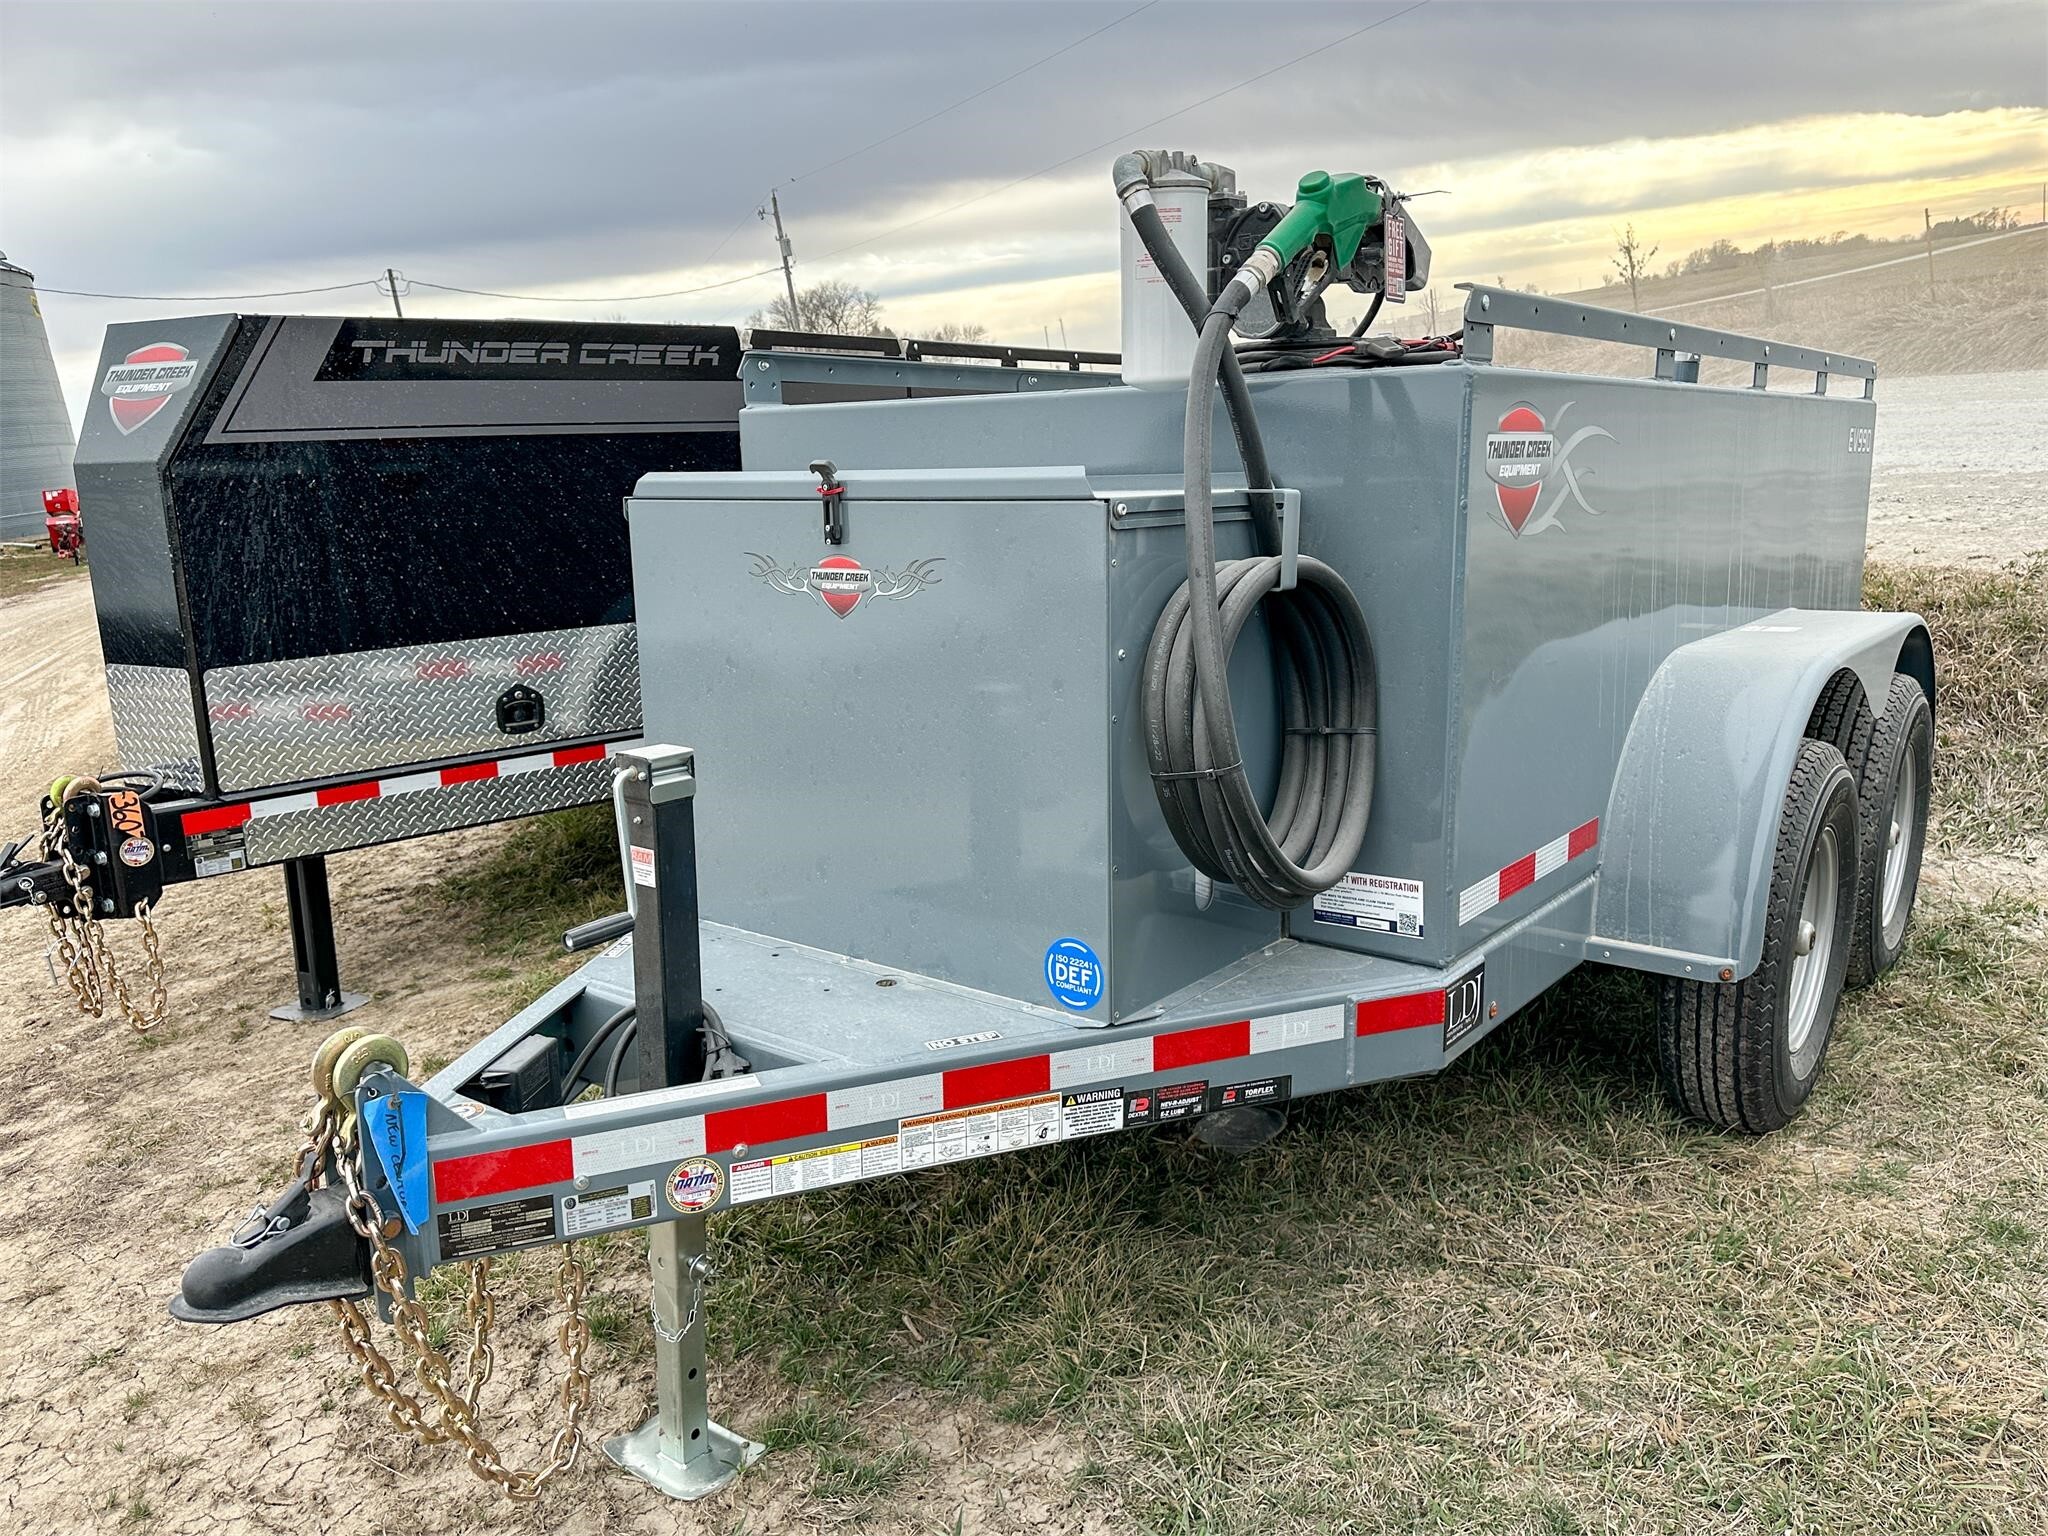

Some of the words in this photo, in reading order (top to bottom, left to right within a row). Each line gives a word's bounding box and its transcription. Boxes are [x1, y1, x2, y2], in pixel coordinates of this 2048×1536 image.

[1388, 219, 1403, 240] FREE
[1388, 238, 1403, 258] GIFT
[352, 339, 571, 365] THUNDER
[580, 343, 722, 367] CREEK
[106, 367, 157, 383] THUNDER
[157, 364, 192, 380] CREEK
[114, 381, 174, 394] EQUIPMENT
[1488, 441, 1525, 459] THUNDER
[1526, 440, 1552, 458] CREEK
[1499, 463, 1541, 478] EQUIPMENT
[811, 570, 844, 583] THUNDER
[845, 572, 869, 583] CREEK
[821, 582, 860, 591] EQUIPMENT
[1350, 876, 1369, 887] WITH
[1369, 878, 1419, 894] REGISTRATION
[1055, 953, 1069, 964] ISO
[1070, 957, 1093, 970] 22241
[1055, 962, 1093, 987] DEF
[1055, 980, 1093, 997] COMPLIANT
[1446, 971, 1484, 1033] LDJ
[933, 1038, 956, 1049] NO
[960, 1033, 998, 1044] STEP
[1076, 1089, 1121, 1104] WARNING
[1244, 1086, 1275, 1098] TORFLEX
[1003, 1101, 1028, 1110] WARNING
[1034, 1095, 1059, 1105] WARNING
[939, 1112, 965, 1122] WARNING
[972, 1106, 997, 1116] WARNING
[1127, 1111, 1149, 1119] DEXTER
[907, 1117, 933, 1127] WARNING
[385, 1113, 400, 1148] NEW
[870, 1136, 896, 1147] WARNING
[794, 1152, 818, 1162] CAUTION
[741, 1161, 765, 1170] DANGER
[448, 1209, 470, 1224] LDJ
